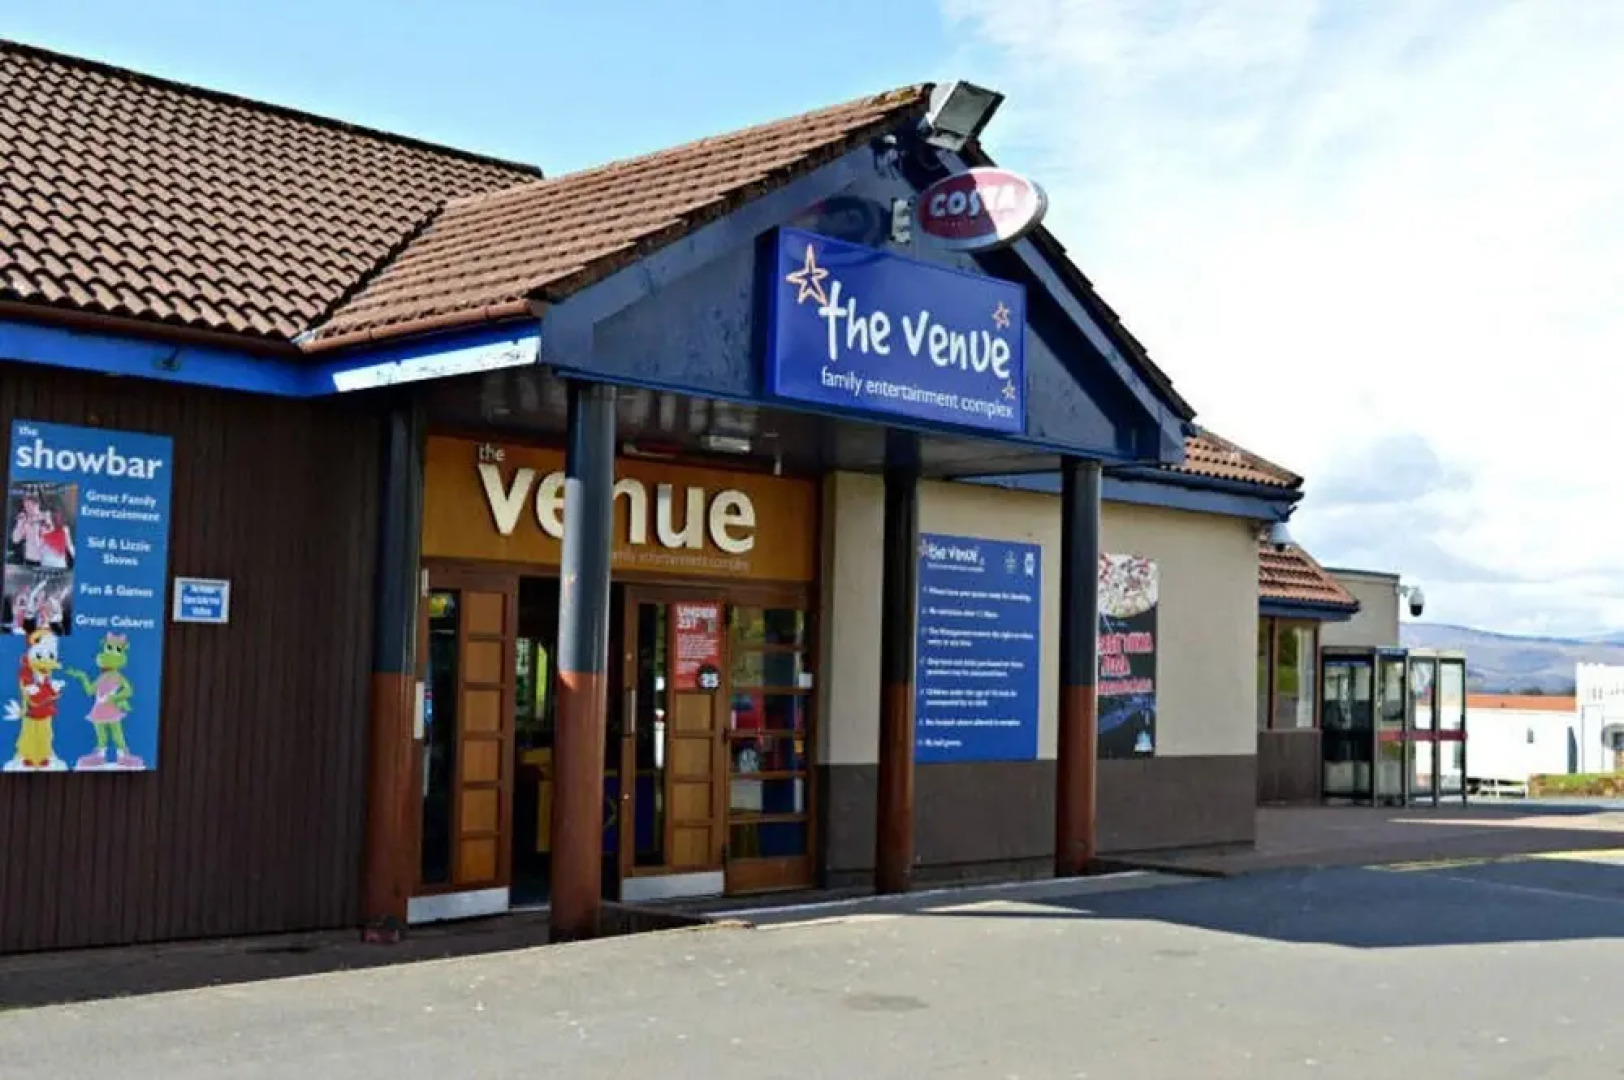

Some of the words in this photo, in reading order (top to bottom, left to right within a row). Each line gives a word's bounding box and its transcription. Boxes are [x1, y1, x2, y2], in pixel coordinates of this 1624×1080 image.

[819, 281, 891, 362] the
[902, 310, 1011, 379] venue
[821, 366, 863, 396] family
[866, 379, 959, 410] entertainment
[961, 397, 1014, 419] complex
[18, 426, 39, 436] the
[15, 438, 163, 480] showbar
[478, 442, 506, 461] the
[85, 489, 118, 503] Great
[121, 493, 156, 509] Family
[477, 463, 756, 554] venue
[81, 506, 160, 521] Entertainment
[103, 553, 138, 566] Shows
[80, 582, 102, 596] Fun
[104, 584, 113, 596] &
[76, 613, 108, 628] Great
[111, 615, 155, 630] Cabaret
